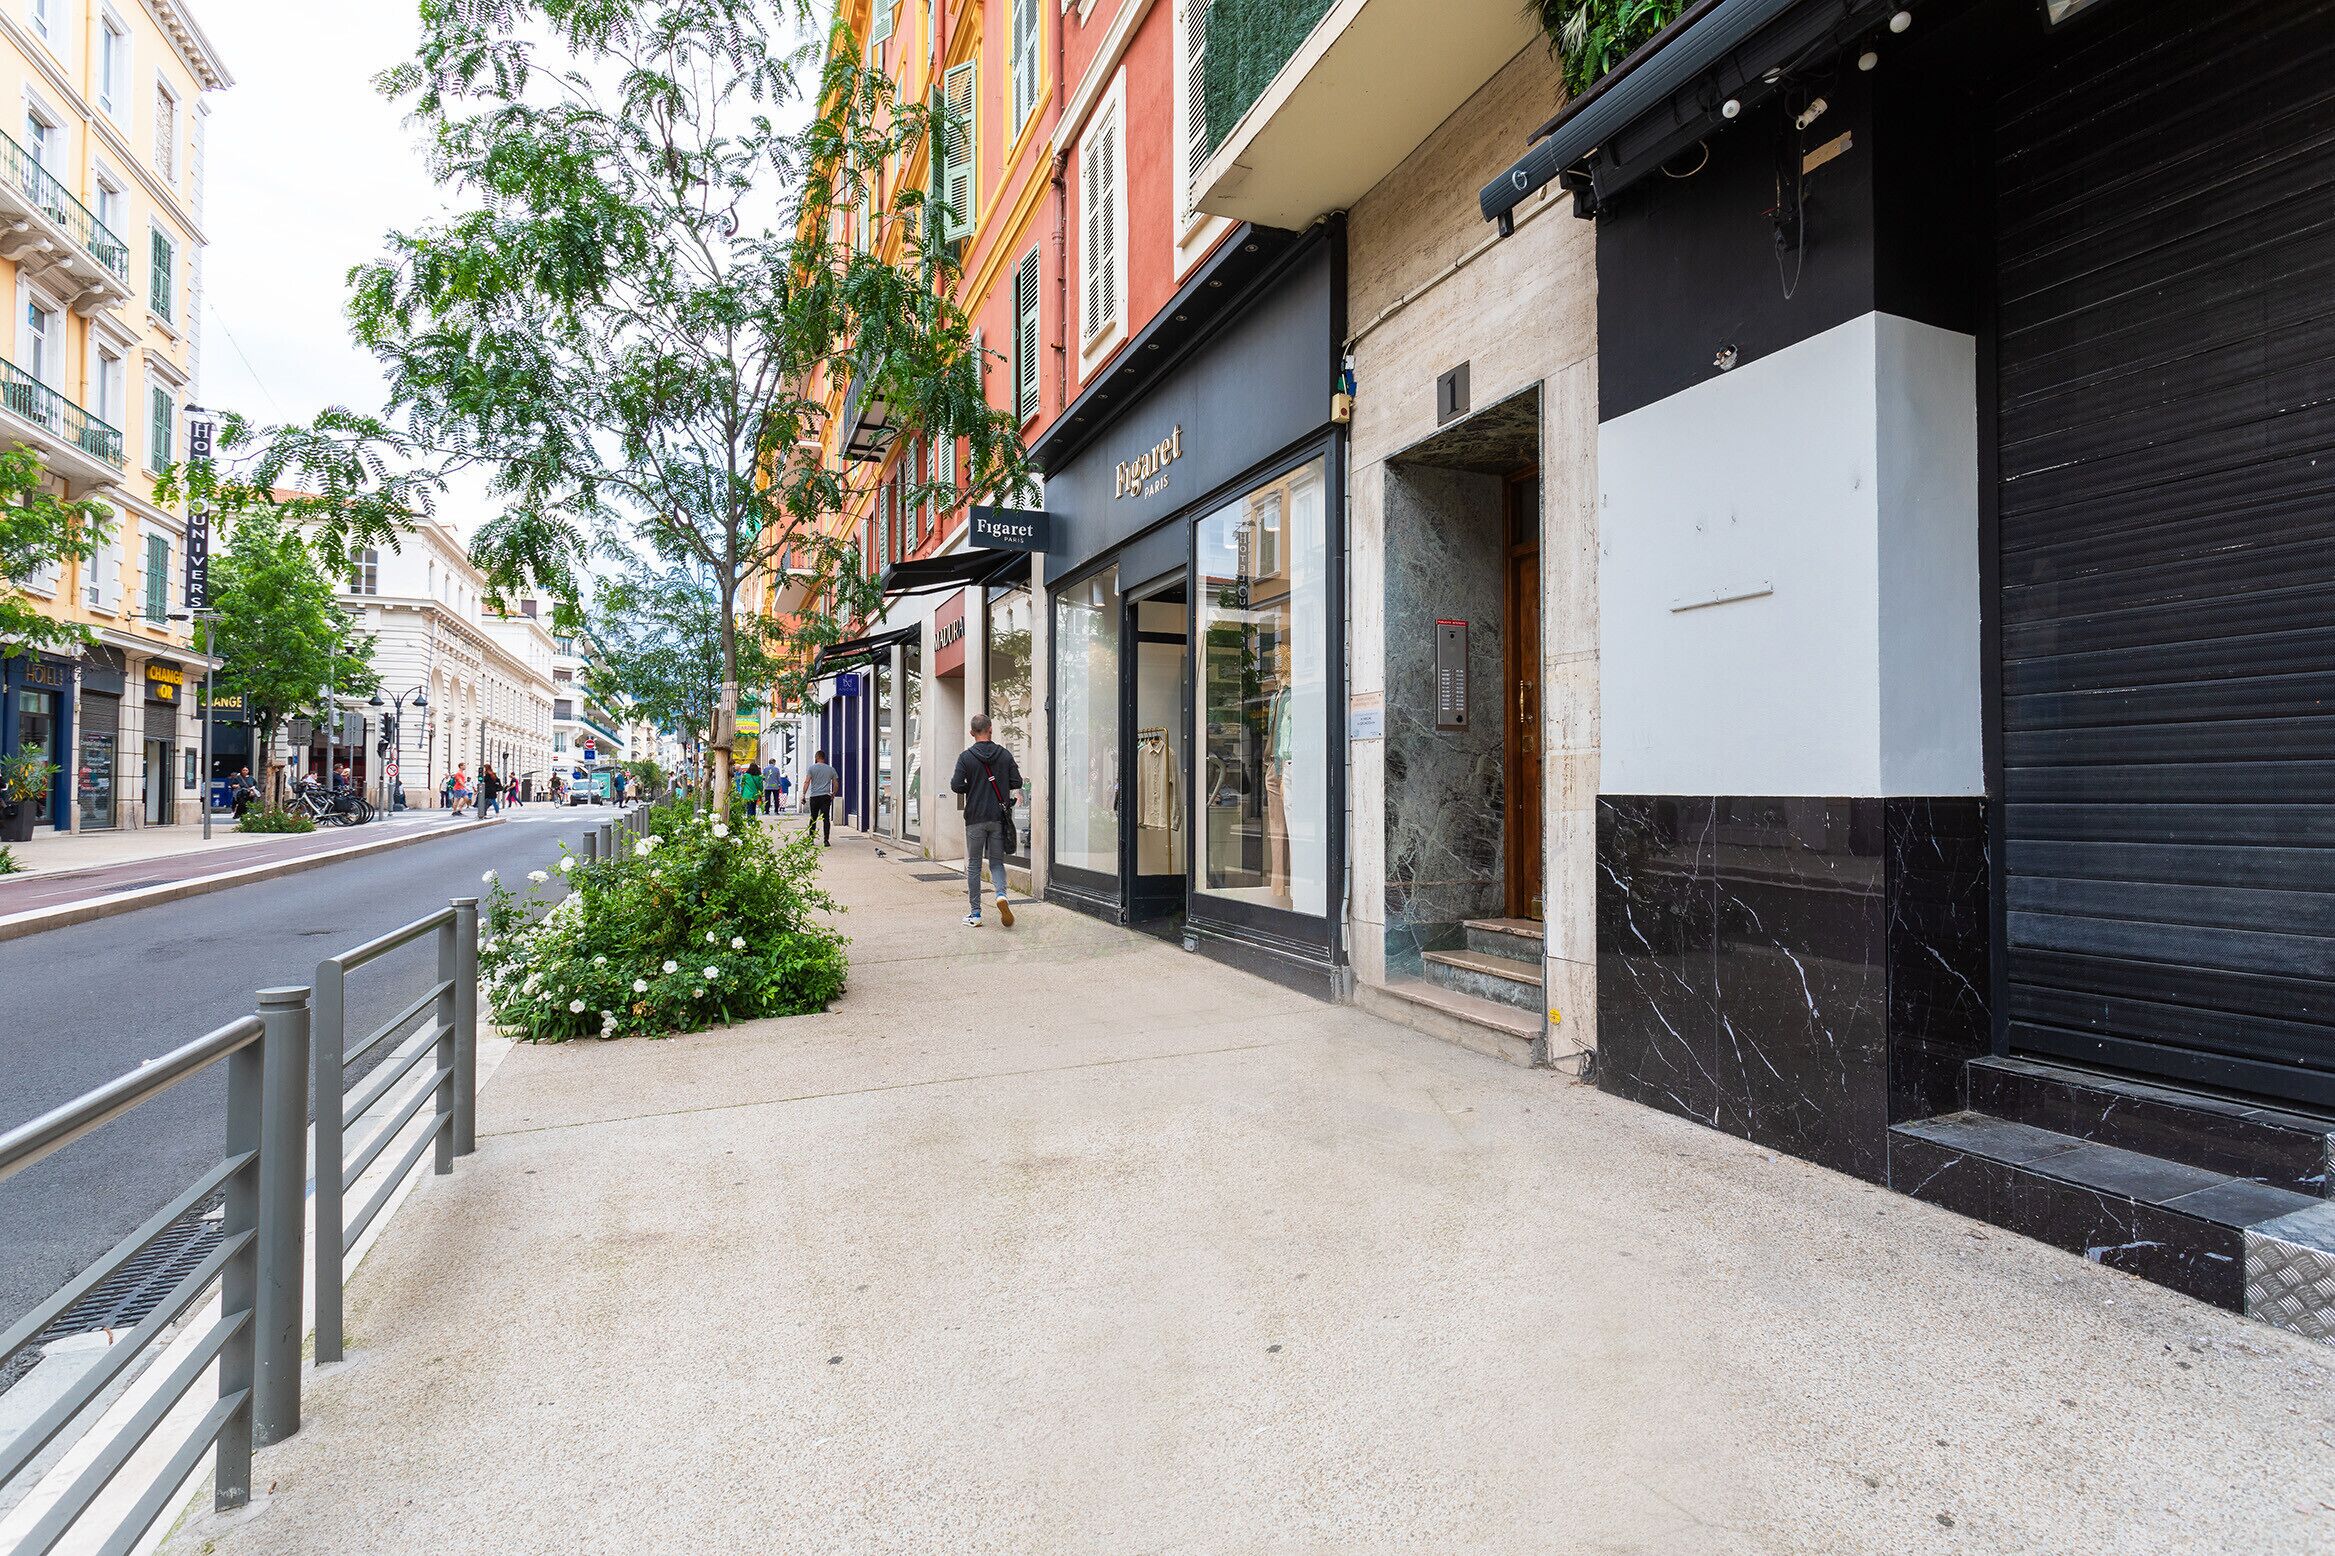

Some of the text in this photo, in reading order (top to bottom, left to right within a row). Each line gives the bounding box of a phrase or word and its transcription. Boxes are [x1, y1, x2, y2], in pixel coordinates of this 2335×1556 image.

[1446, 373, 1460, 416] 1
[1115, 423, 1183, 499] Figaret
[1144, 474, 1169, 500] PARIS
[976, 518, 1034, 538] Figaret
[1003, 536, 1024, 544] PARIS
[933, 615, 966, 653] MADURA
[148, 665, 185, 686] CHANGE
[157, 684, 174, 700] OR
[201, 695, 243, 708] ANGE
